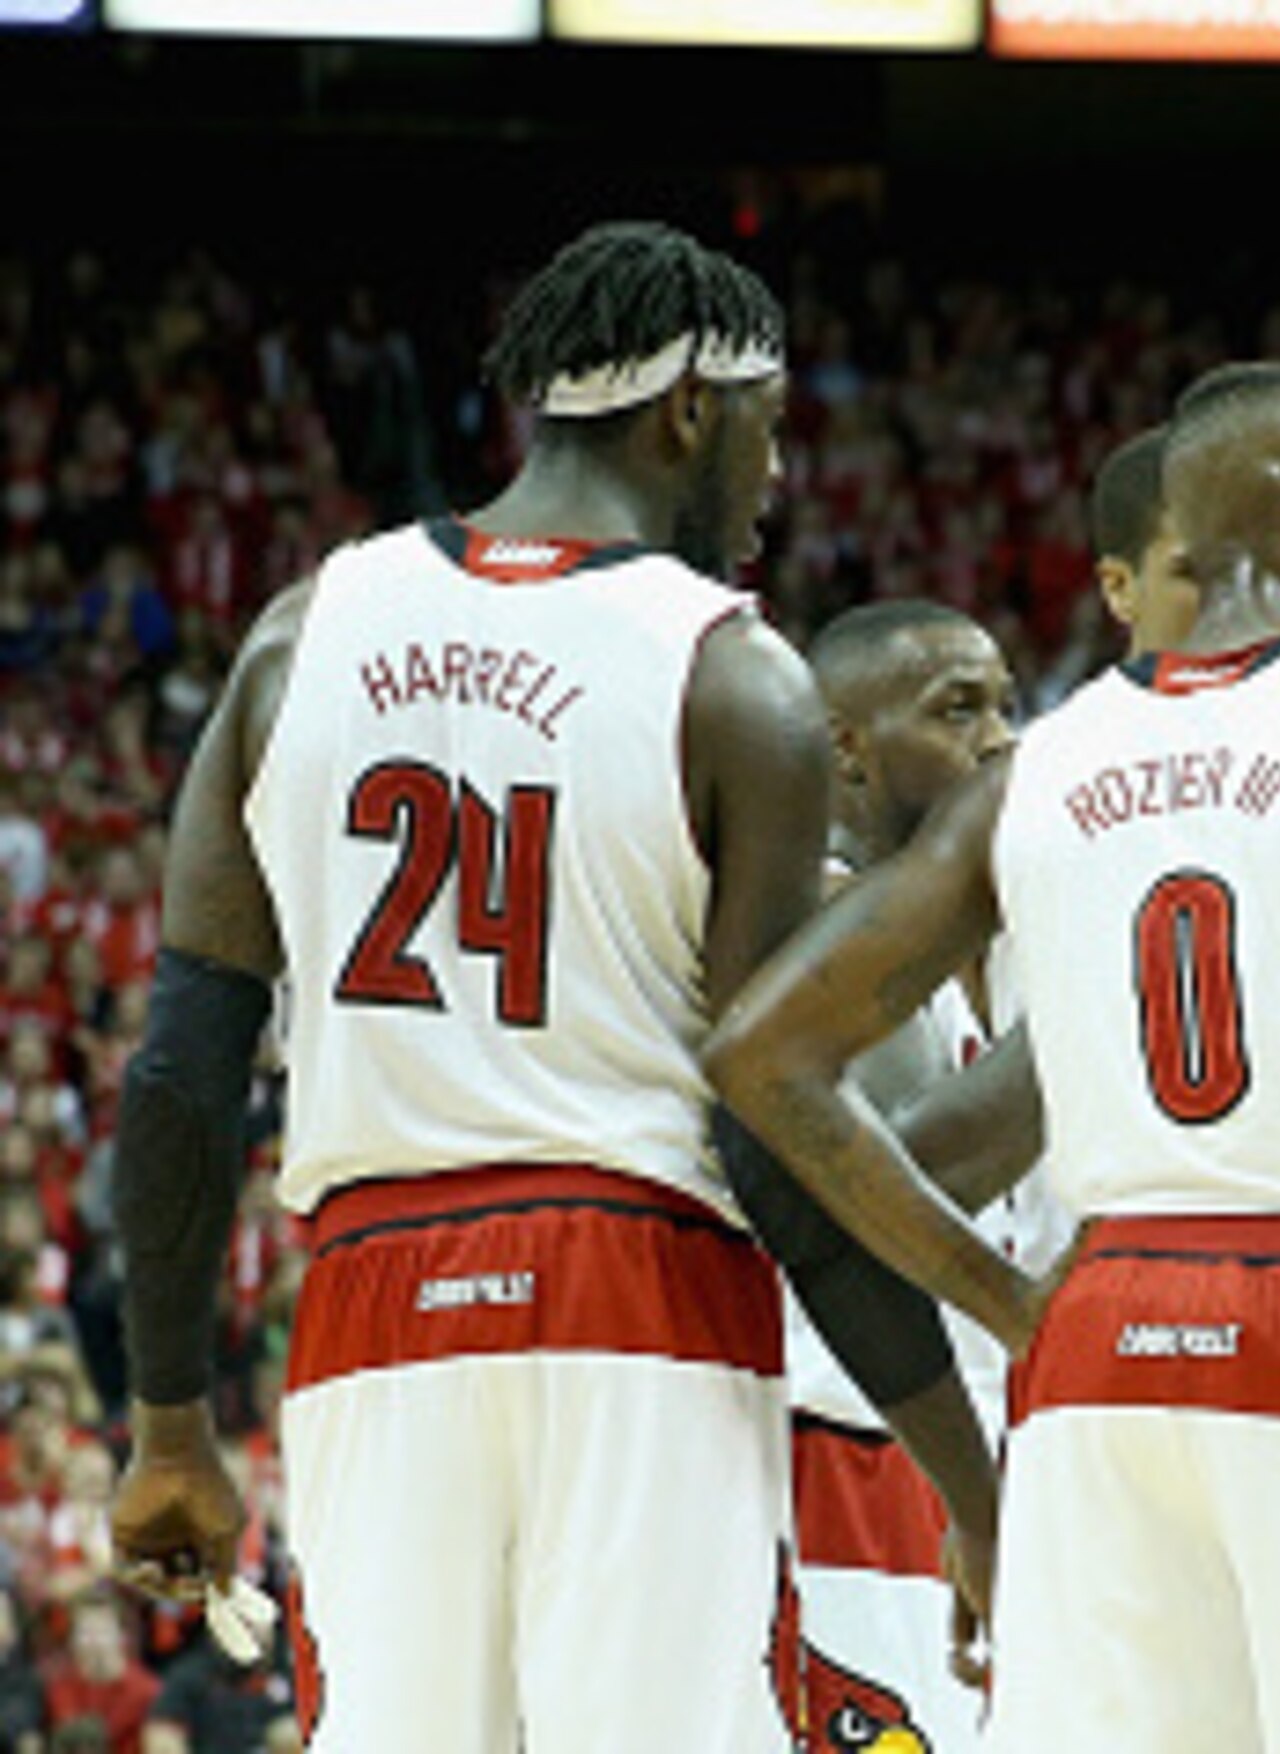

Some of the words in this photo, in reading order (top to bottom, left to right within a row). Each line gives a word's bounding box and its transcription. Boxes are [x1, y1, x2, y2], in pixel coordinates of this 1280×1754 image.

[361, 643, 583, 740] HARRELL
[334, 758, 557, 1027] 24
[1133, 868, 1251, 1125] 0
